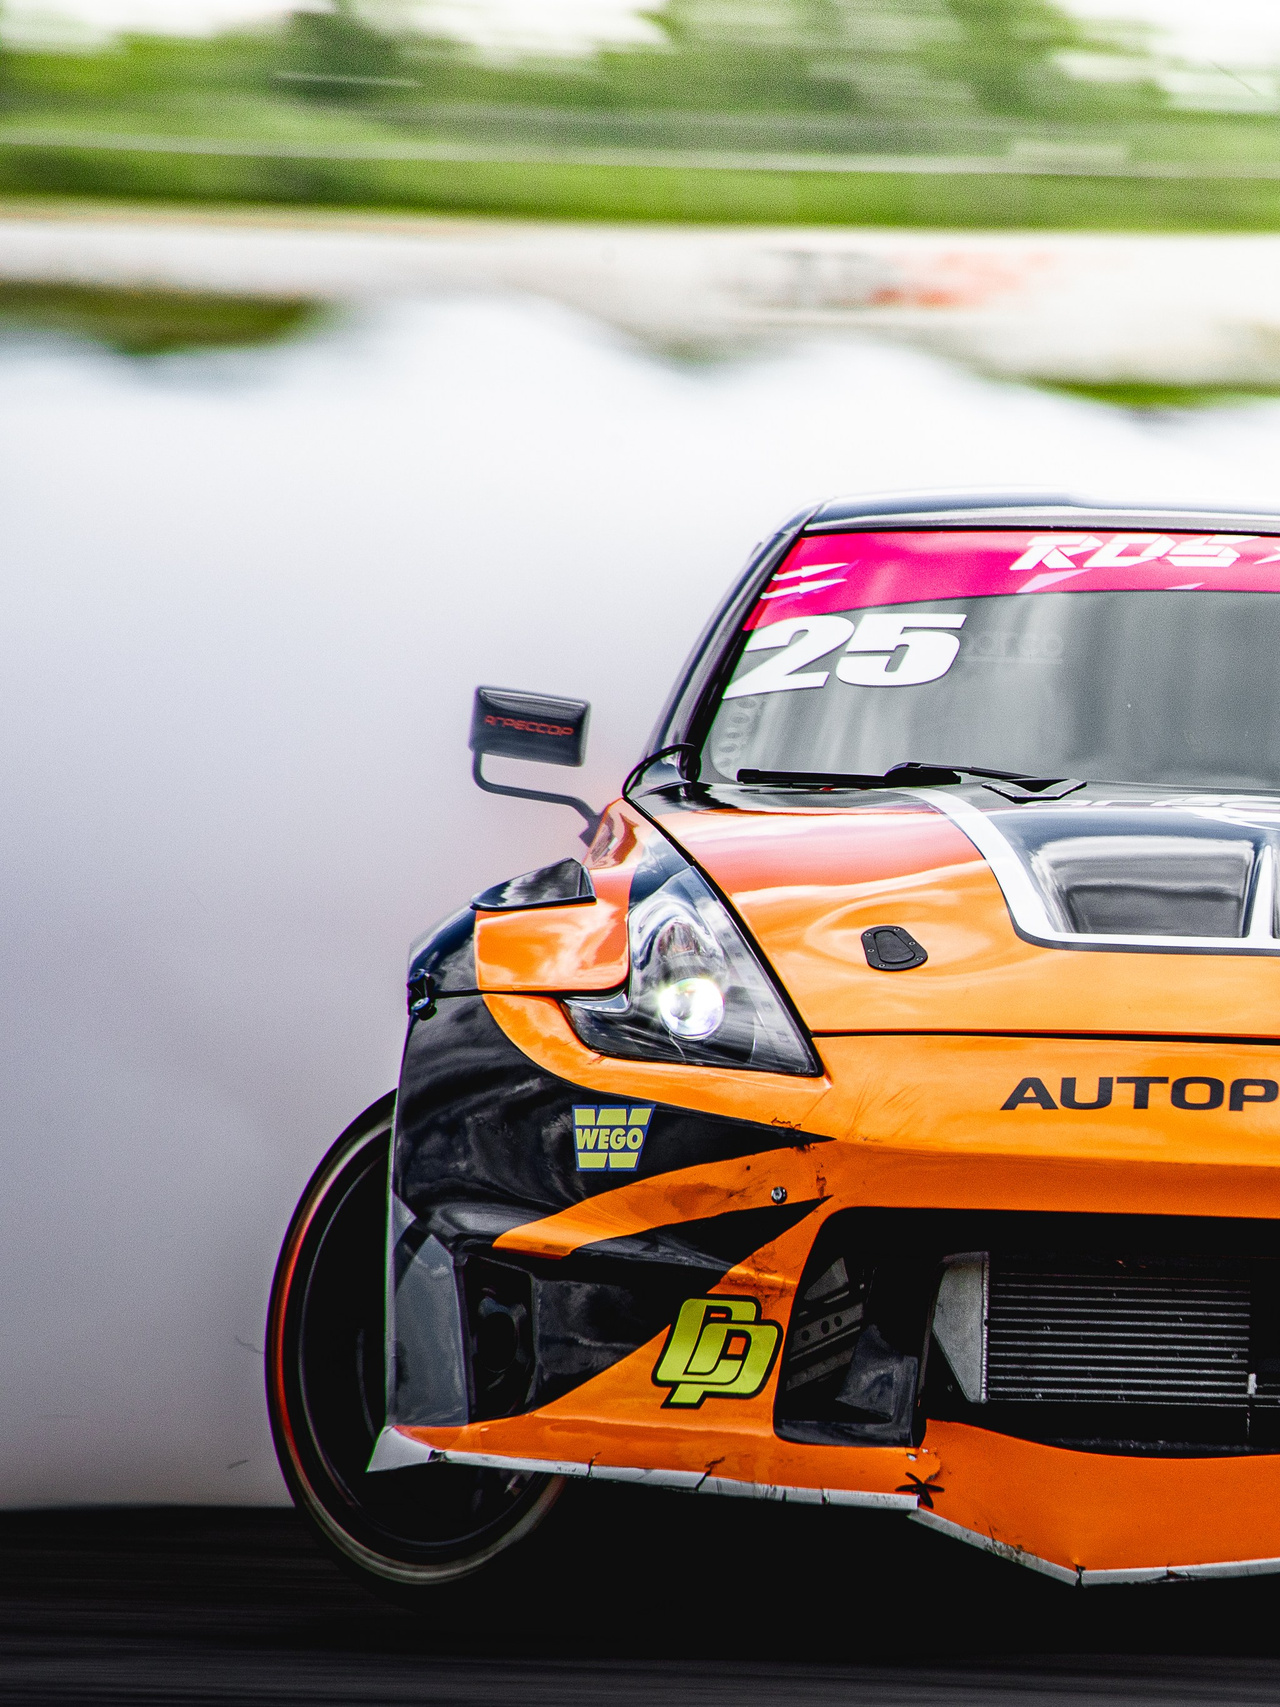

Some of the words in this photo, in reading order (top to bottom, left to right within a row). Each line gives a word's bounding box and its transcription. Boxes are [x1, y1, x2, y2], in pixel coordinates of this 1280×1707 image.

[1009, 534, 1260, 570] RDS
[722, 613, 968, 700] 25
[576, 1128, 644, 1150] WEGO
